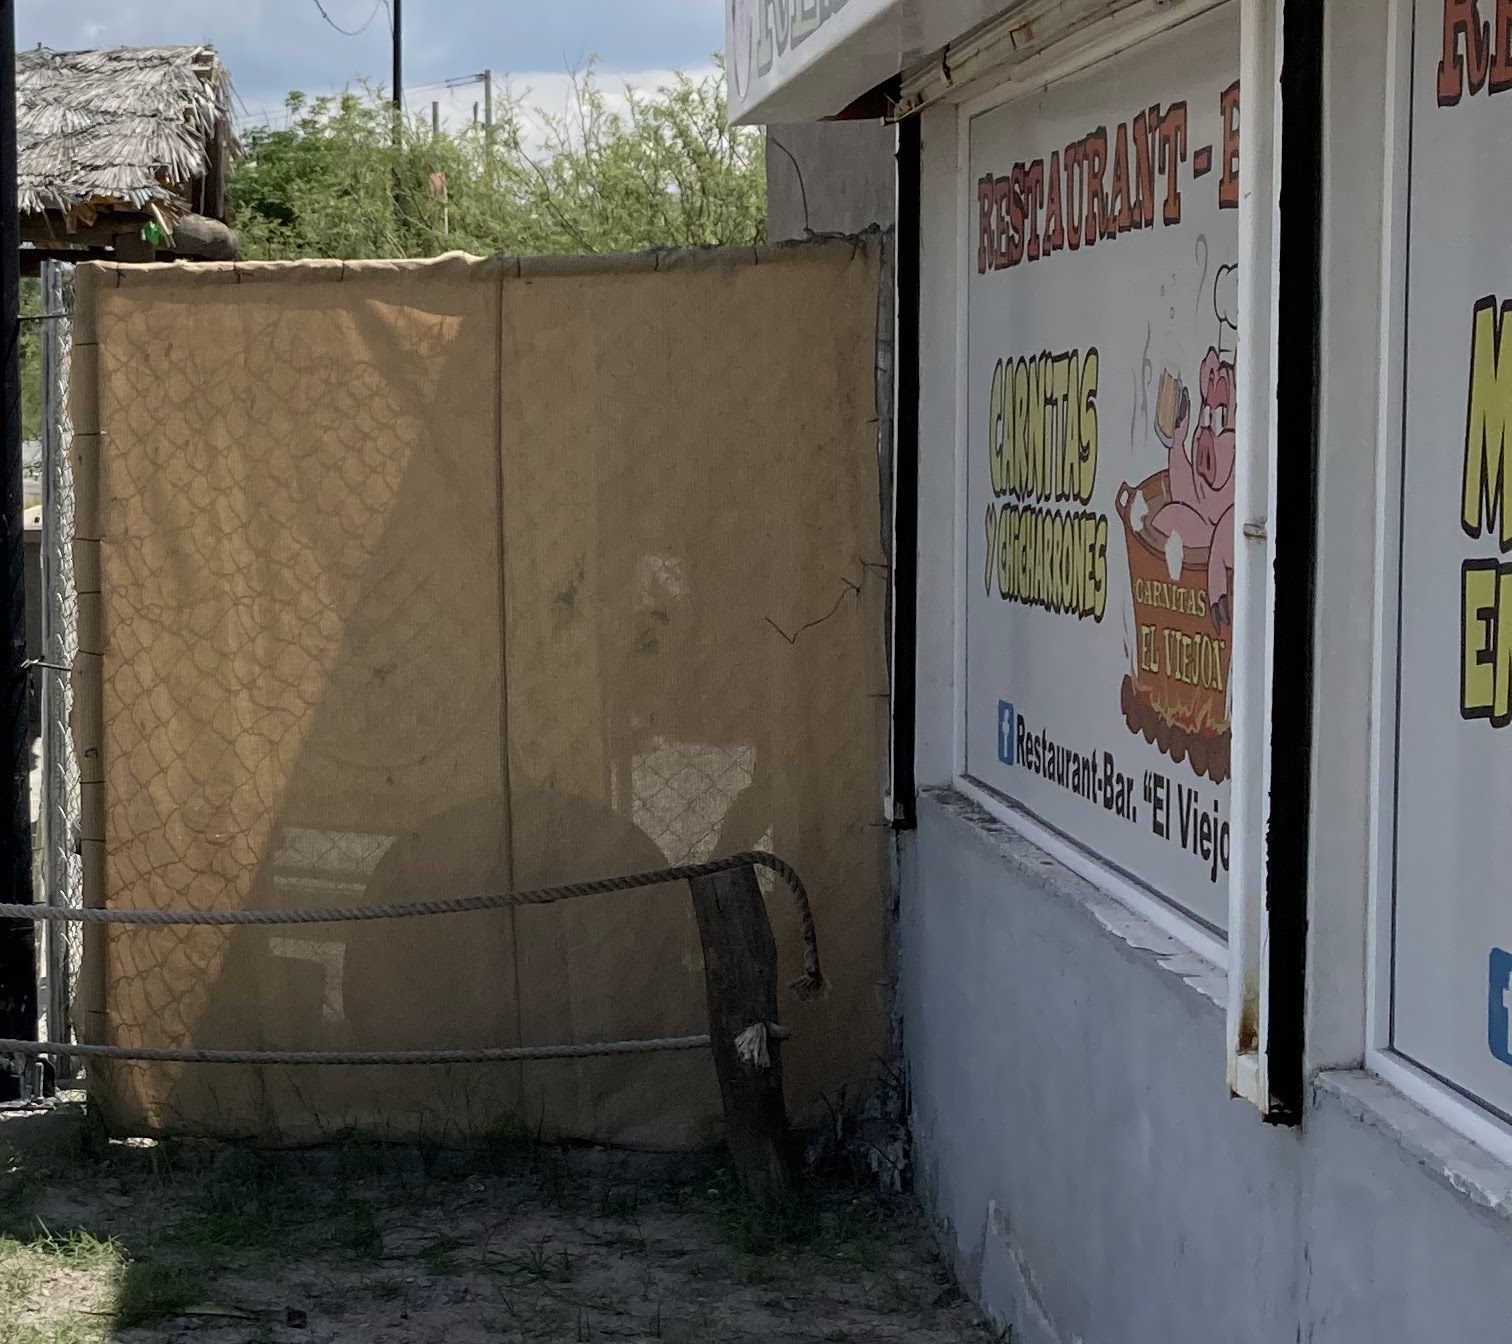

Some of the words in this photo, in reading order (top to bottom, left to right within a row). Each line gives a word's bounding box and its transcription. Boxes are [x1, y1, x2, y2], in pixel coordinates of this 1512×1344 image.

[978, 100, 1187, 274] RESTAURANT
[984, 502, 997, 598] Y
[1136, 578, 1207, 617] CARNITAS
[1141, 624, 1159, 672] EL
